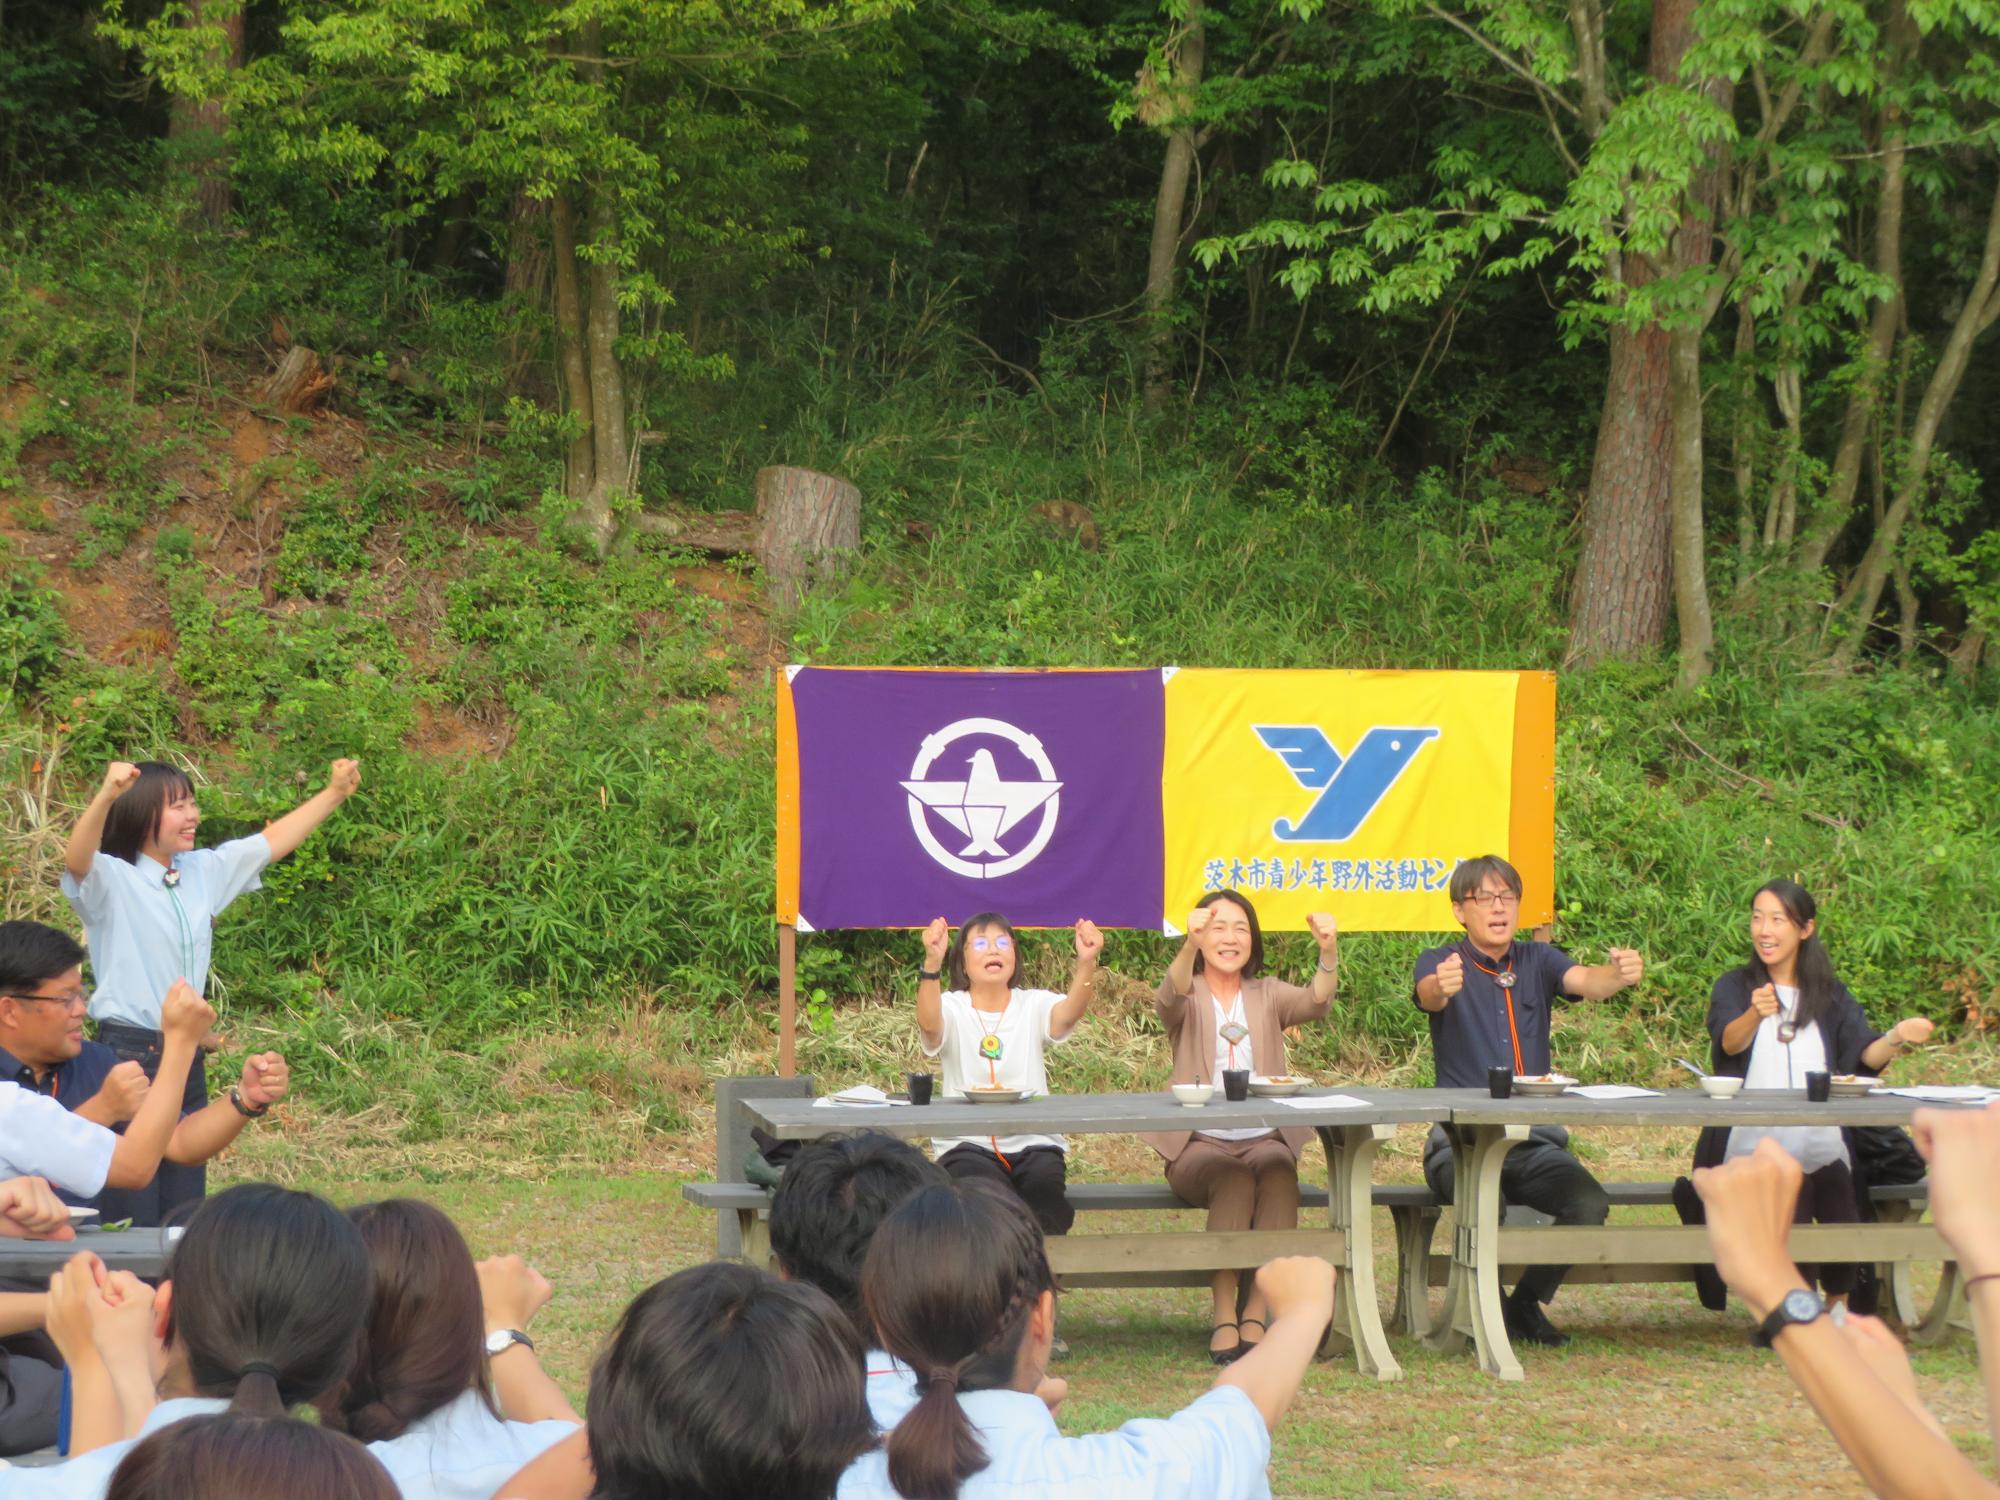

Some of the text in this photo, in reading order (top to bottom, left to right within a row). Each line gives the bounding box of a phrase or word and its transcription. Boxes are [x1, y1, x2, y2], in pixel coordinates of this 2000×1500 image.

[1204, 857, 1467, 891] 茨木市青少年野外活動セン
